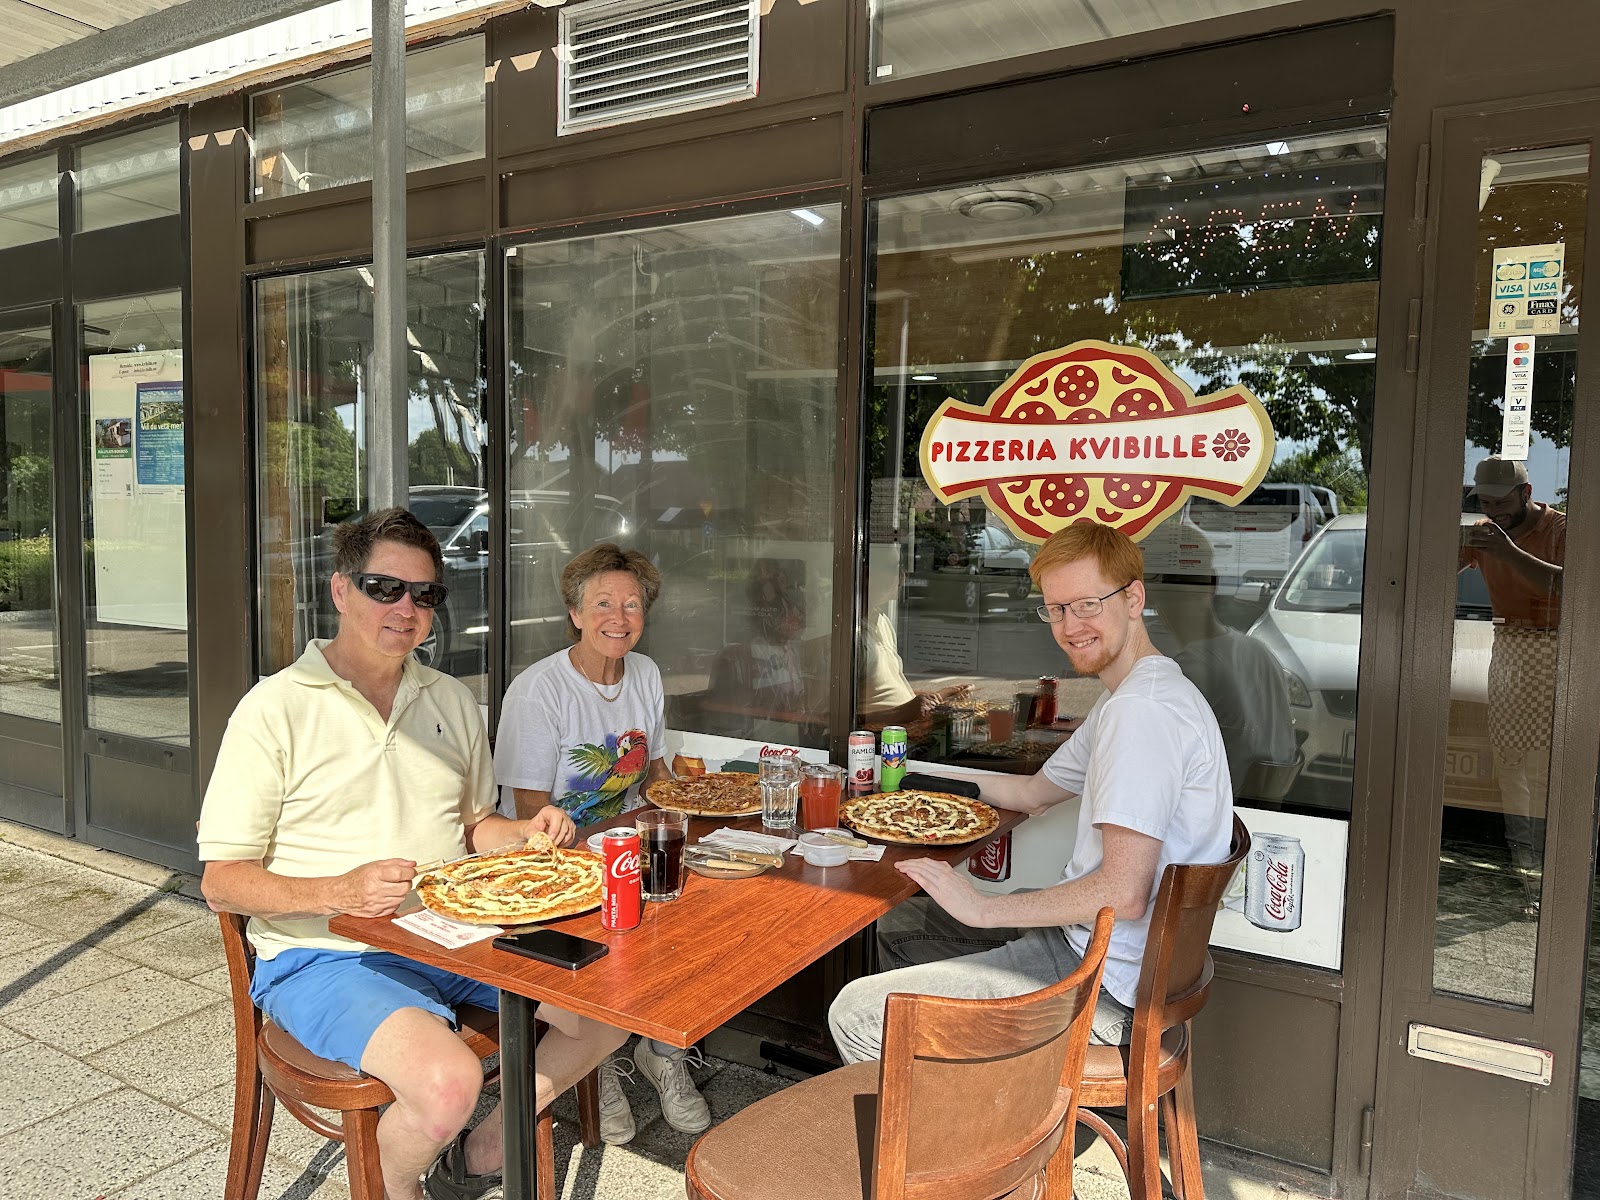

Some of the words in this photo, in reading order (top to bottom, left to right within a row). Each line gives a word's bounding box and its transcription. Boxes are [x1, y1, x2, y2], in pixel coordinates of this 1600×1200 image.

[1500, 284, 1523, 293] VISA
[1533, 282, 1557, 291] VISA
[150, 422, 158, 430] du
[158, 422, 170, 430] veta
[931, 438, 1057, 463] PIZZERIA
[1069, 434, 1208, 461] KVIBILLE
